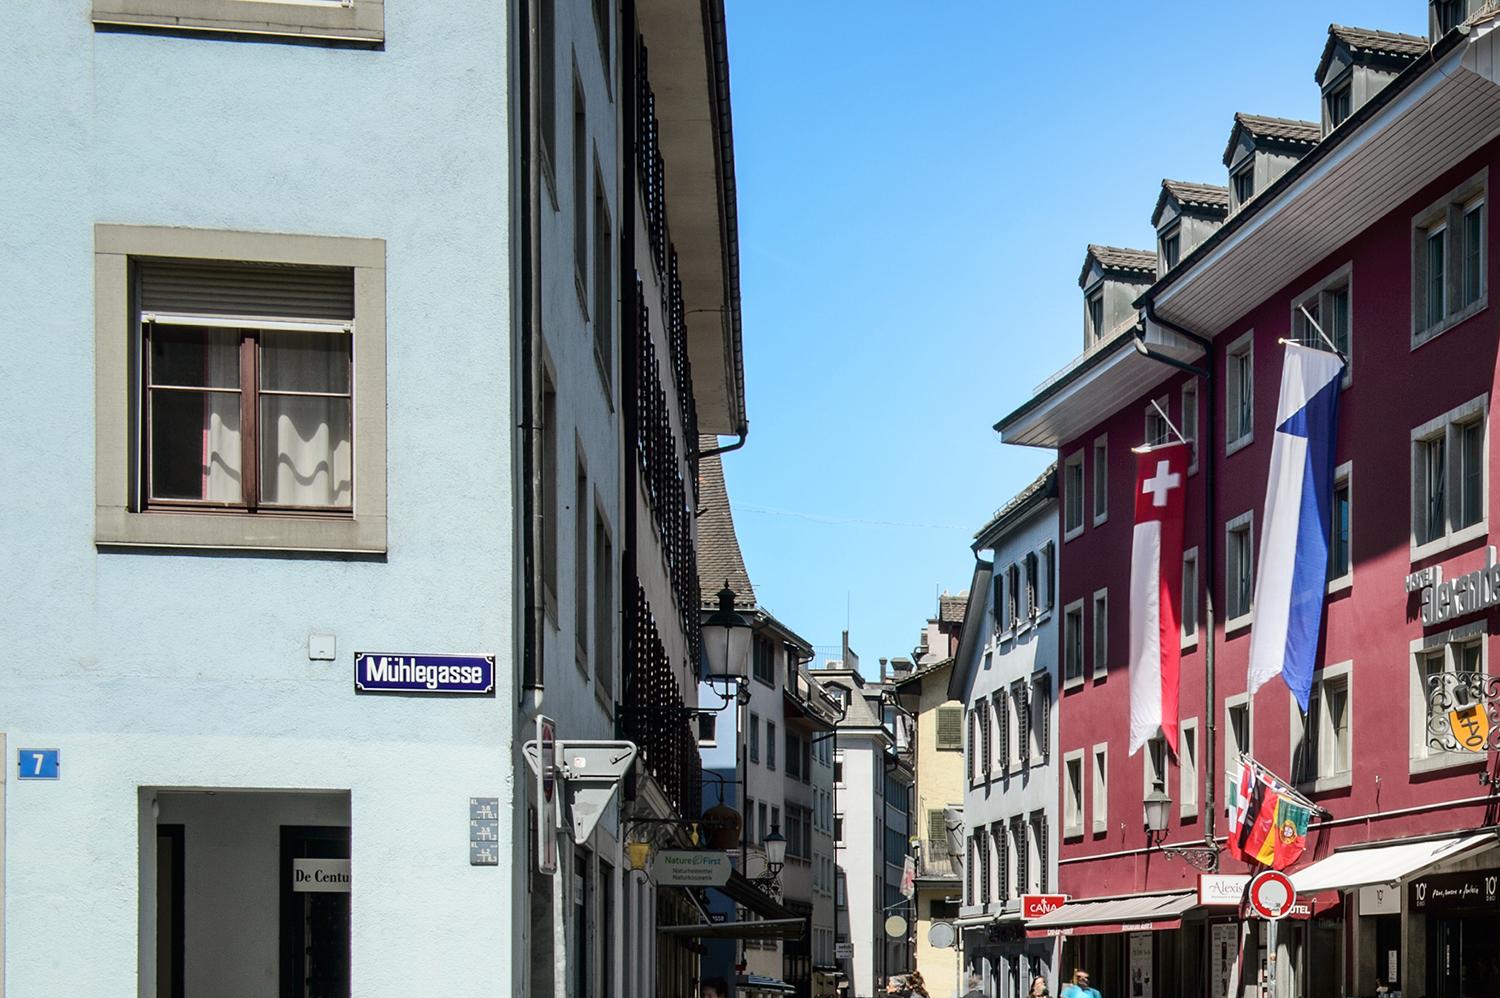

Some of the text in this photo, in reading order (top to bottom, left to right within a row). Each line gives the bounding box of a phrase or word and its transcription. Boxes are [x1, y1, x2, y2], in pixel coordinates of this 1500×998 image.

[366, 656, 483, 689] Mühlegasse
[33, 753, 44, 775] 7
[664, 855, 721, 865] Nature First
[295, 869, 312, 883] De
[1209, 881, 1243, 895] Alexis
